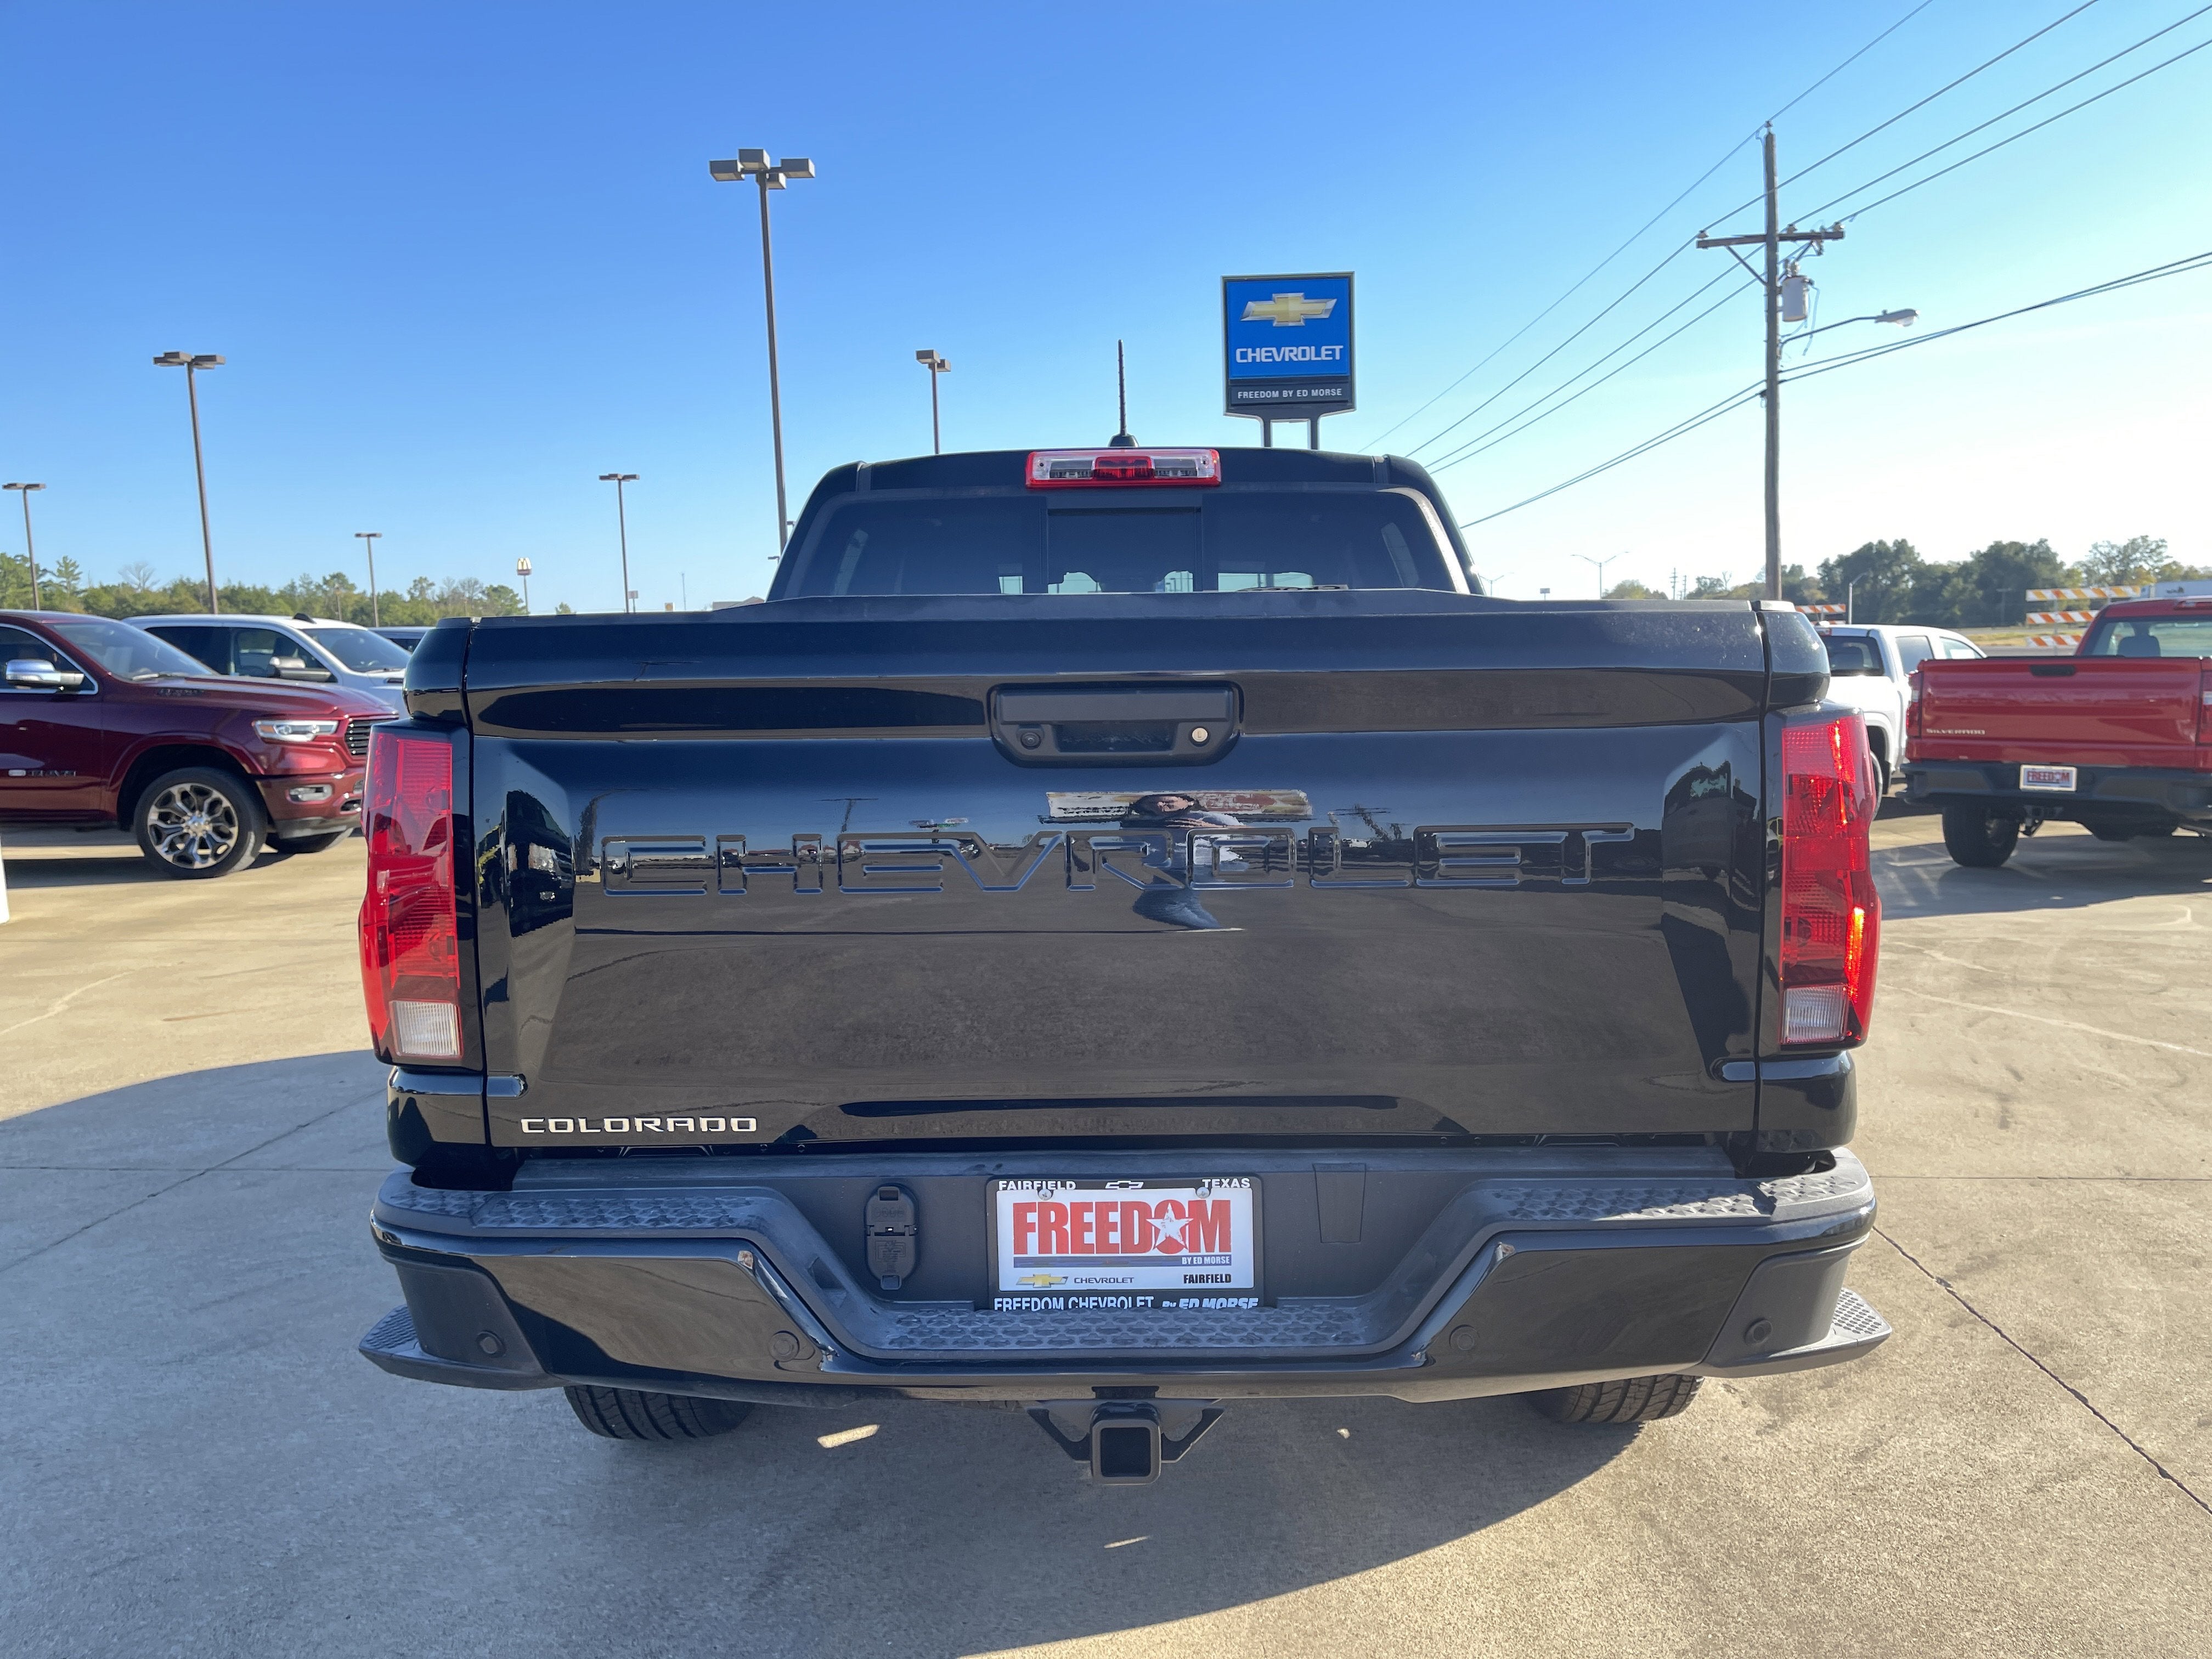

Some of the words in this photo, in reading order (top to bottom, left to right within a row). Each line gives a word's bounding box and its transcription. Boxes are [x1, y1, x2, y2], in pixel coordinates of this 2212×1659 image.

[1236, 345, 1343, 363] CHEVROLET
[1238, 391, 1279, 399] FREEDOM
[1311, 388, 1342, 397] MORSE
[601, 822, 1634, 896] CHEVROLET
[521, 1116, 758, 1133] COLORADO
[998, 1180, 1076, 1190] FAIRFIELD
[1201, 1177, 1250, 1188] TEXAS
[1013, 1199, 1232, 1255] FREEDOM
[1204, 1256, 1230, 1264] MORSE
[1183, 1274, 1232, 1283] FAIRFIELD
[994, 1297, 1064, 1312] FREEDOM
